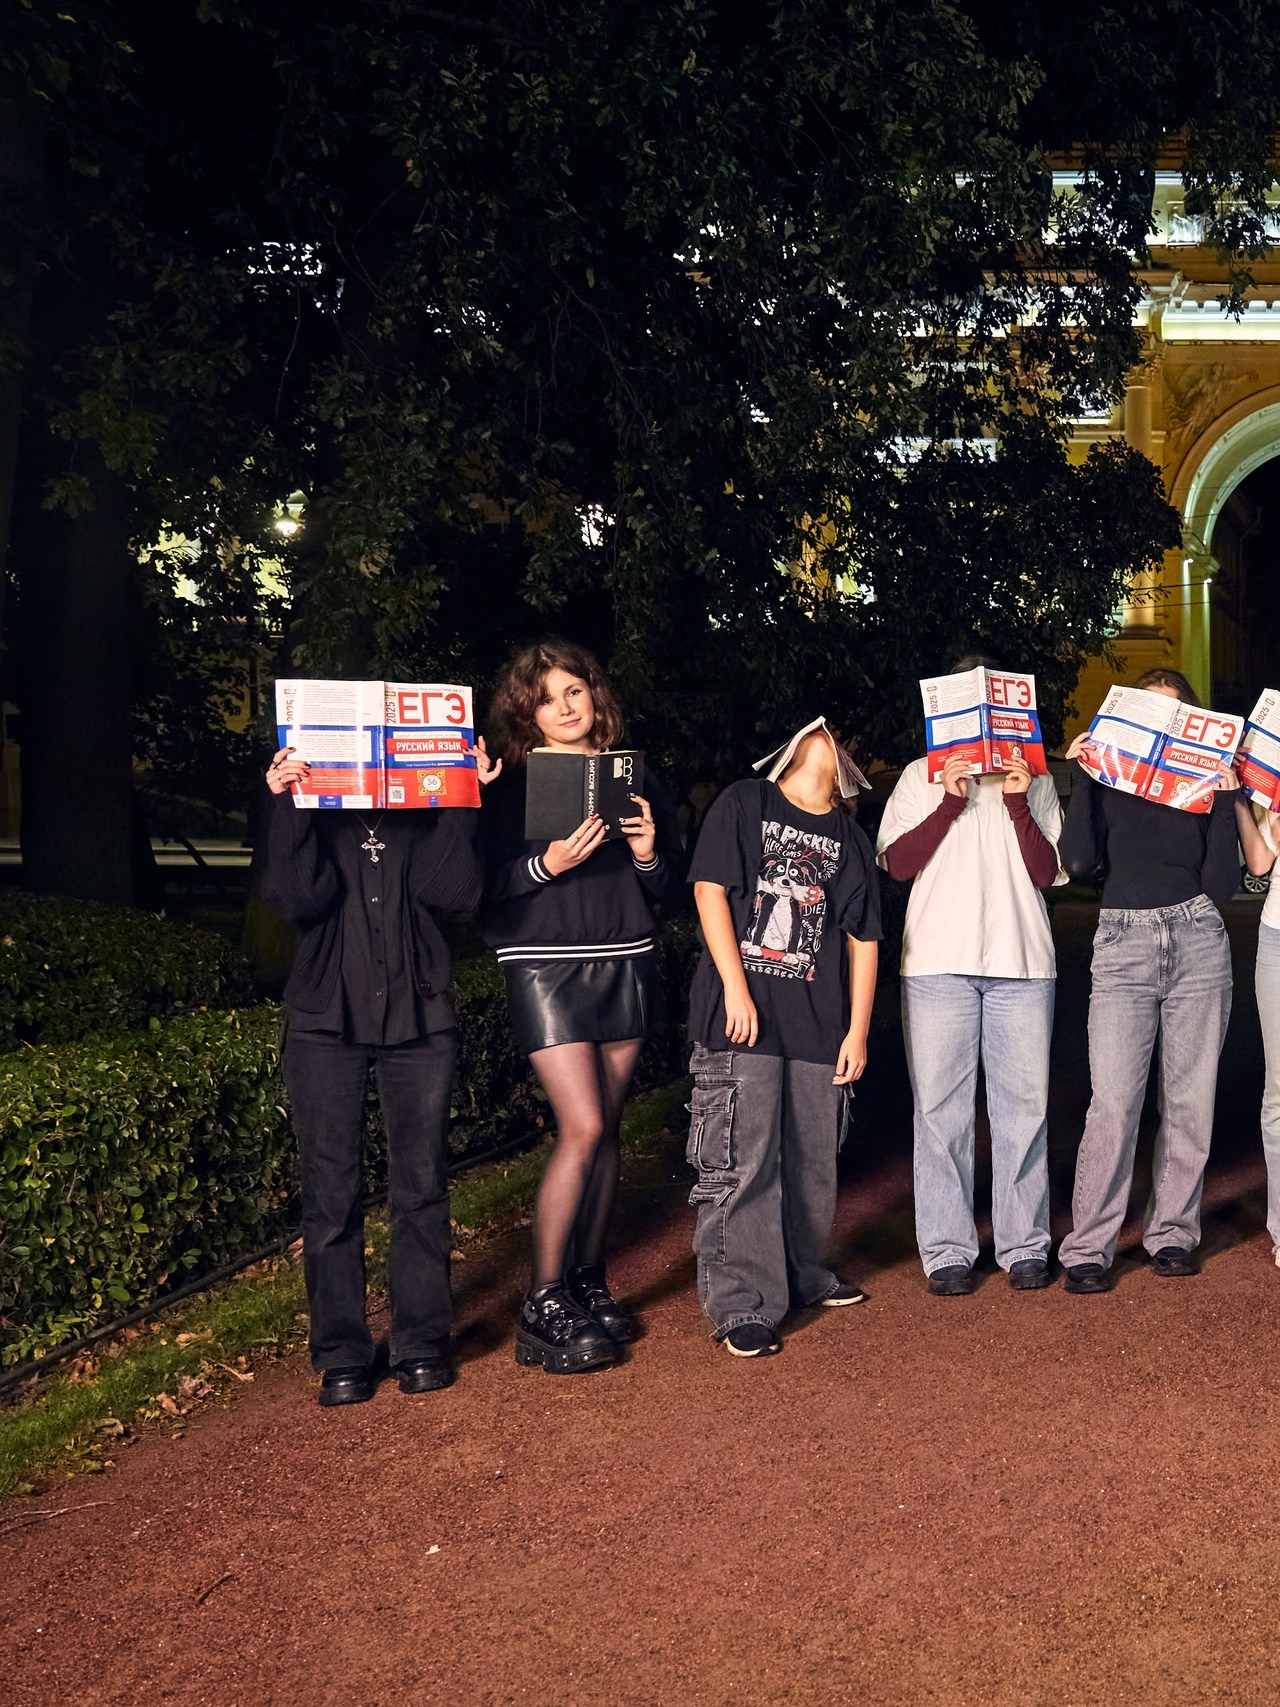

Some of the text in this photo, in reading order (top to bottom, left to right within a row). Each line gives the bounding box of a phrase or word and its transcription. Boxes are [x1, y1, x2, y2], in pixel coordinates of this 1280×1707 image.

[990, 676, 1031, 707] ЕГЭ
[286, 699, 294, 722] 2025
[386, 702, 397, 723] 2025
[398, 691, 466, 724] ЕГЭ
[929, 694, 939, 714] 2025
[1104, 699, 1118, 715] 2025
[1255, 706, 1270, 725] 2025
[1170, 717, 1184, 736] 2025
[1181, 713, 1237, 748] ЕГЭ
[396, 740, 462, 752] РУССКИЙ ЯЗЫК
[1170, 750, 1199, 764] РУССКИЙ
[1198, 757, 1218, 769] ЯЗЫК
[426, 778, 438, 786] 36
[627, 776, 633, 785] 2
[780, 825, 841, 861] PICKLES
[787, 842, 797, 850] HE
[782, 850, 802, 858] COMES
[803, 900, 827, 917] DIE!
